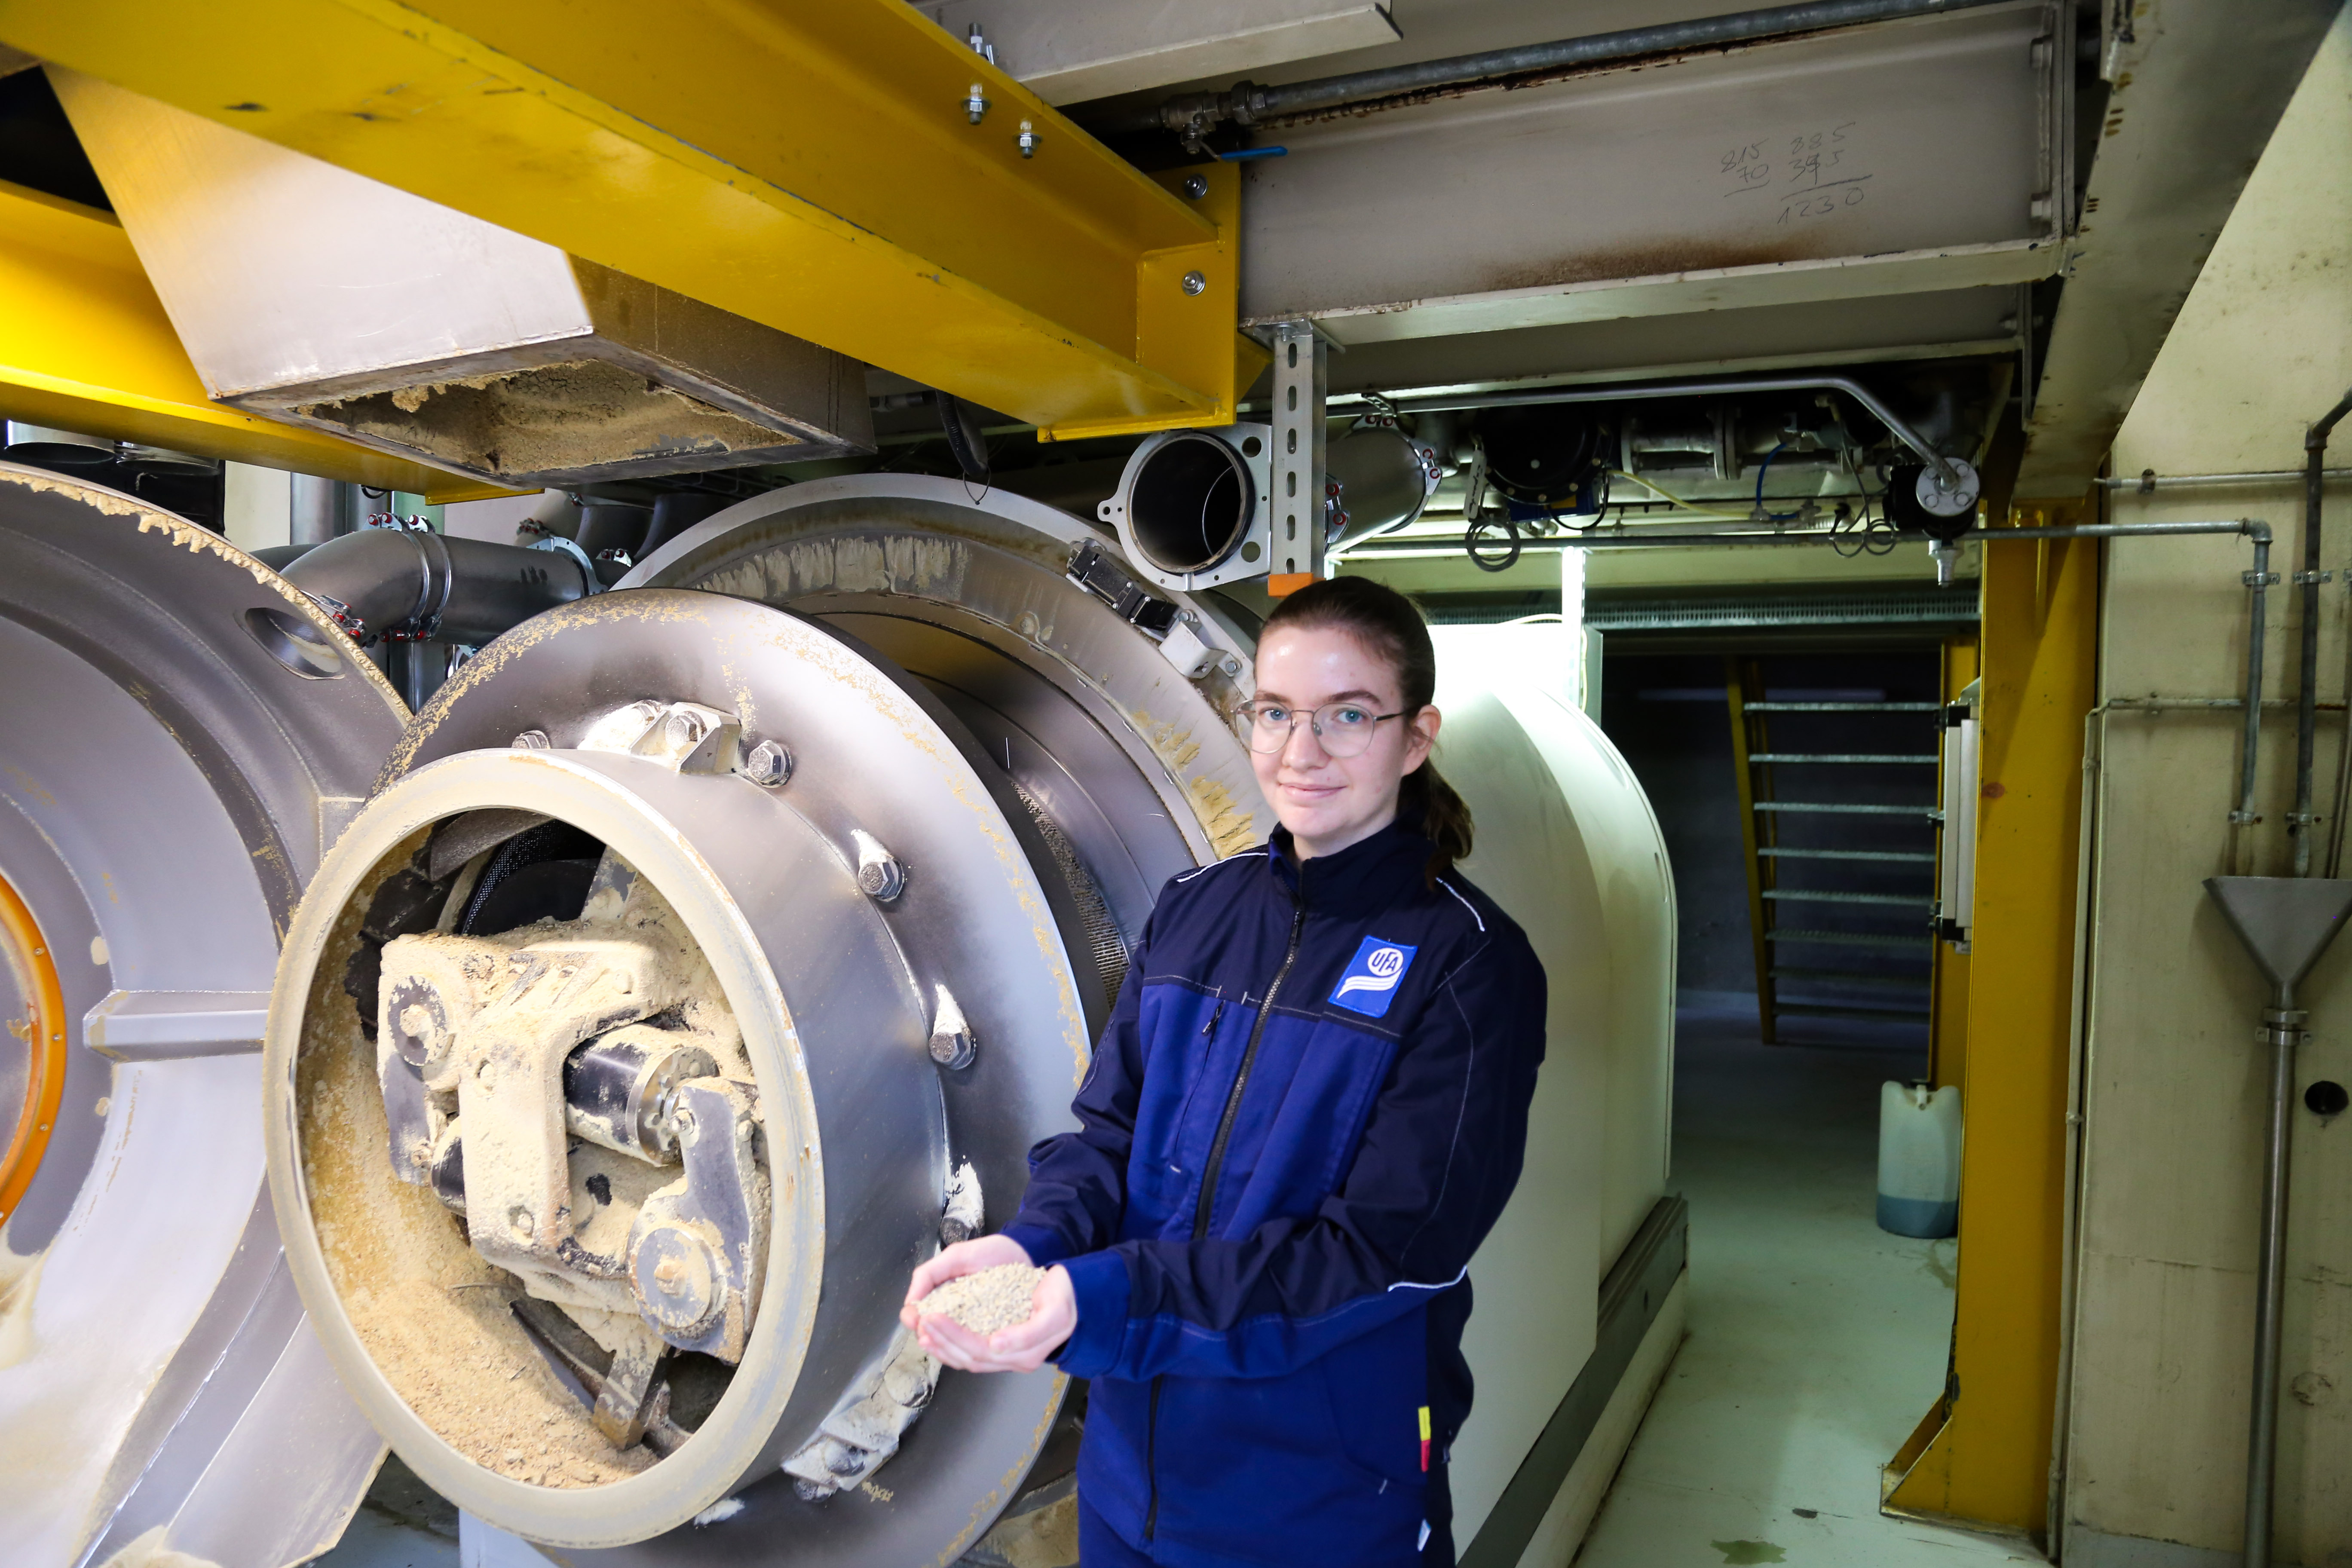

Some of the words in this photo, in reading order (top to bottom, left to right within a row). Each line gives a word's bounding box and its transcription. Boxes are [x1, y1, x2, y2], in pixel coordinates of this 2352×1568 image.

[1721, 138, 1770, 173] 815
[1736, 164, 1769, 183] 70
[1777, 187, 1864, 224] 1230
[1372, 951, 1398, 972] UFA
